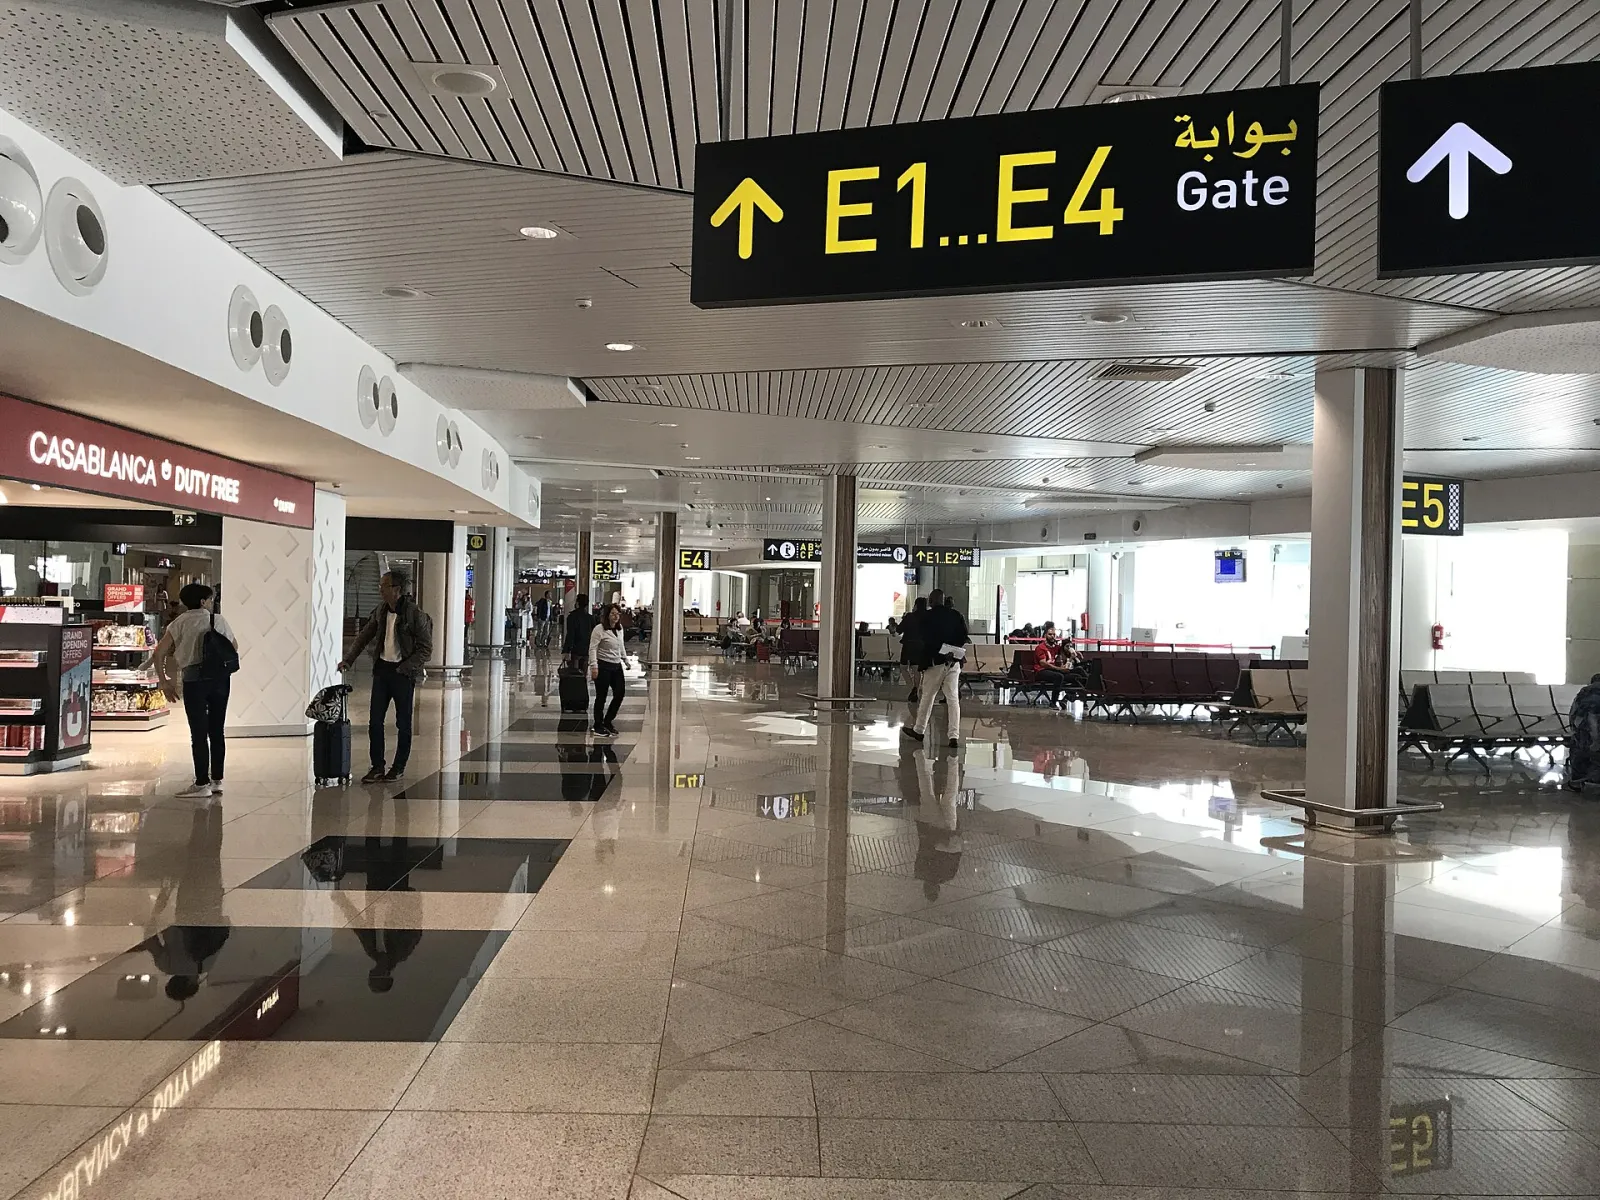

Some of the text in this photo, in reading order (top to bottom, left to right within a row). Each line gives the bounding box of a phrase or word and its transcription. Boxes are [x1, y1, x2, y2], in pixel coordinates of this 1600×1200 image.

[1174, 111, 1298, 162] بوابة
[1177, 170, 1290, 211] Gate
[825, 145, 1124, 255] E1...E4
[29, 430, 240, 504] CASABLANCA DUTY FREE
[800, 543, 806, 551] A
[808, 543, 814, 551] B
[681, 551, 703, 568] E4
[800, 551, 806, 559] C
[595, 561, 612, 574] E3
[63, 631, 83, 640] GRAND
[62, 640, 88, 649] OPENING
